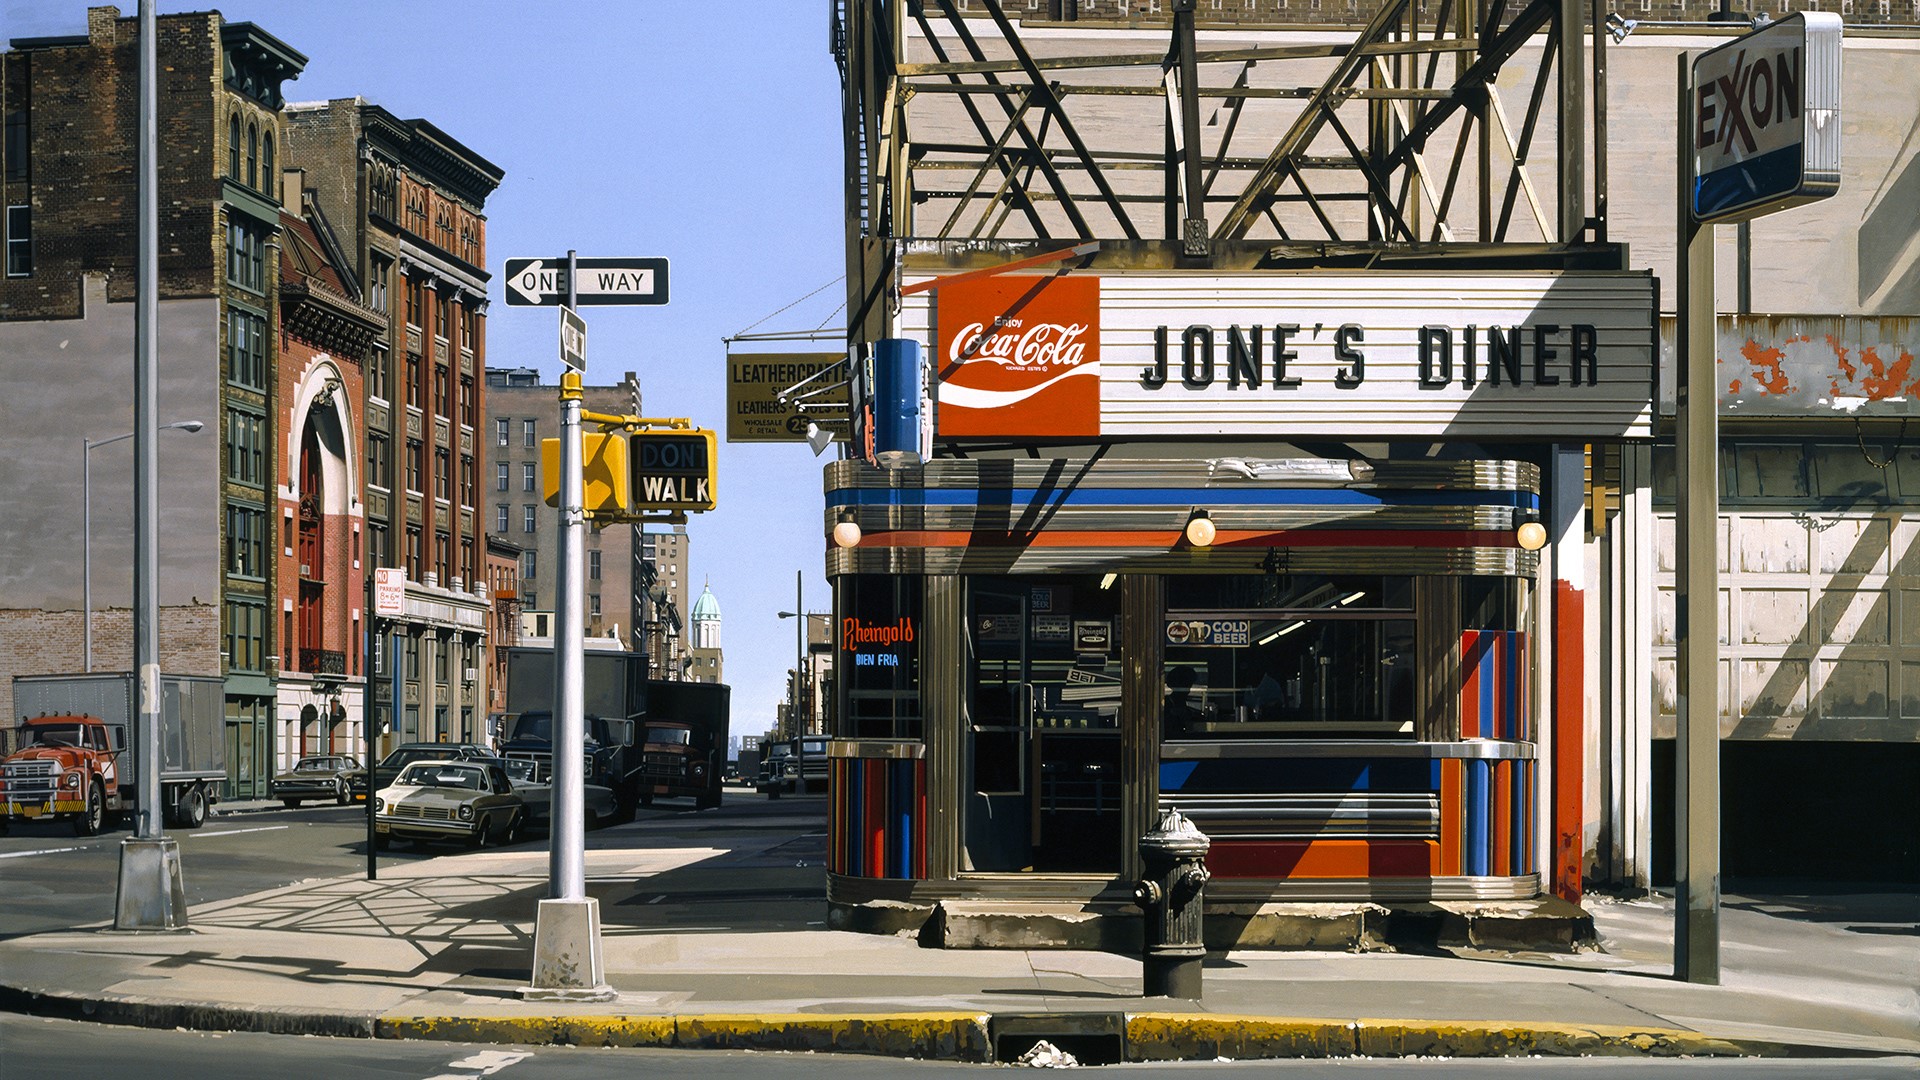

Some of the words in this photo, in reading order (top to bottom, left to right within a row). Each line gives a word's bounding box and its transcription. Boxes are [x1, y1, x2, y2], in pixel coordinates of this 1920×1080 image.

[1697, 46, 1800, 155] EXXON
[522, 271, 566, 291] ONE
[598, 272, 644, 291] WAY
[994, 315, 1023, 329] Enjoy
[949, 322, 1089, 367] Coca-Cola
[1141, 323, 1365, 389] JONE'S
[1419, 323, 1598, 390] DINER
[737, 401, 787, 415] LEATHERS
[743, 419, 783, 427] WHOLESALE
[791, 418, 808, 432] 25
[642, 476, 711, 502] WALK
[377, 571, 388, 582] NO
[379, 585, 401, 593] PARKING
[842, 616, 914, 652] Rheingold
[1212, 621, 1248, 633] COLD
[1213, 633, 1247, 644] BEER
[855, 653, 875, 666] BIEN
[877, 653, 899, 667] FRIA
